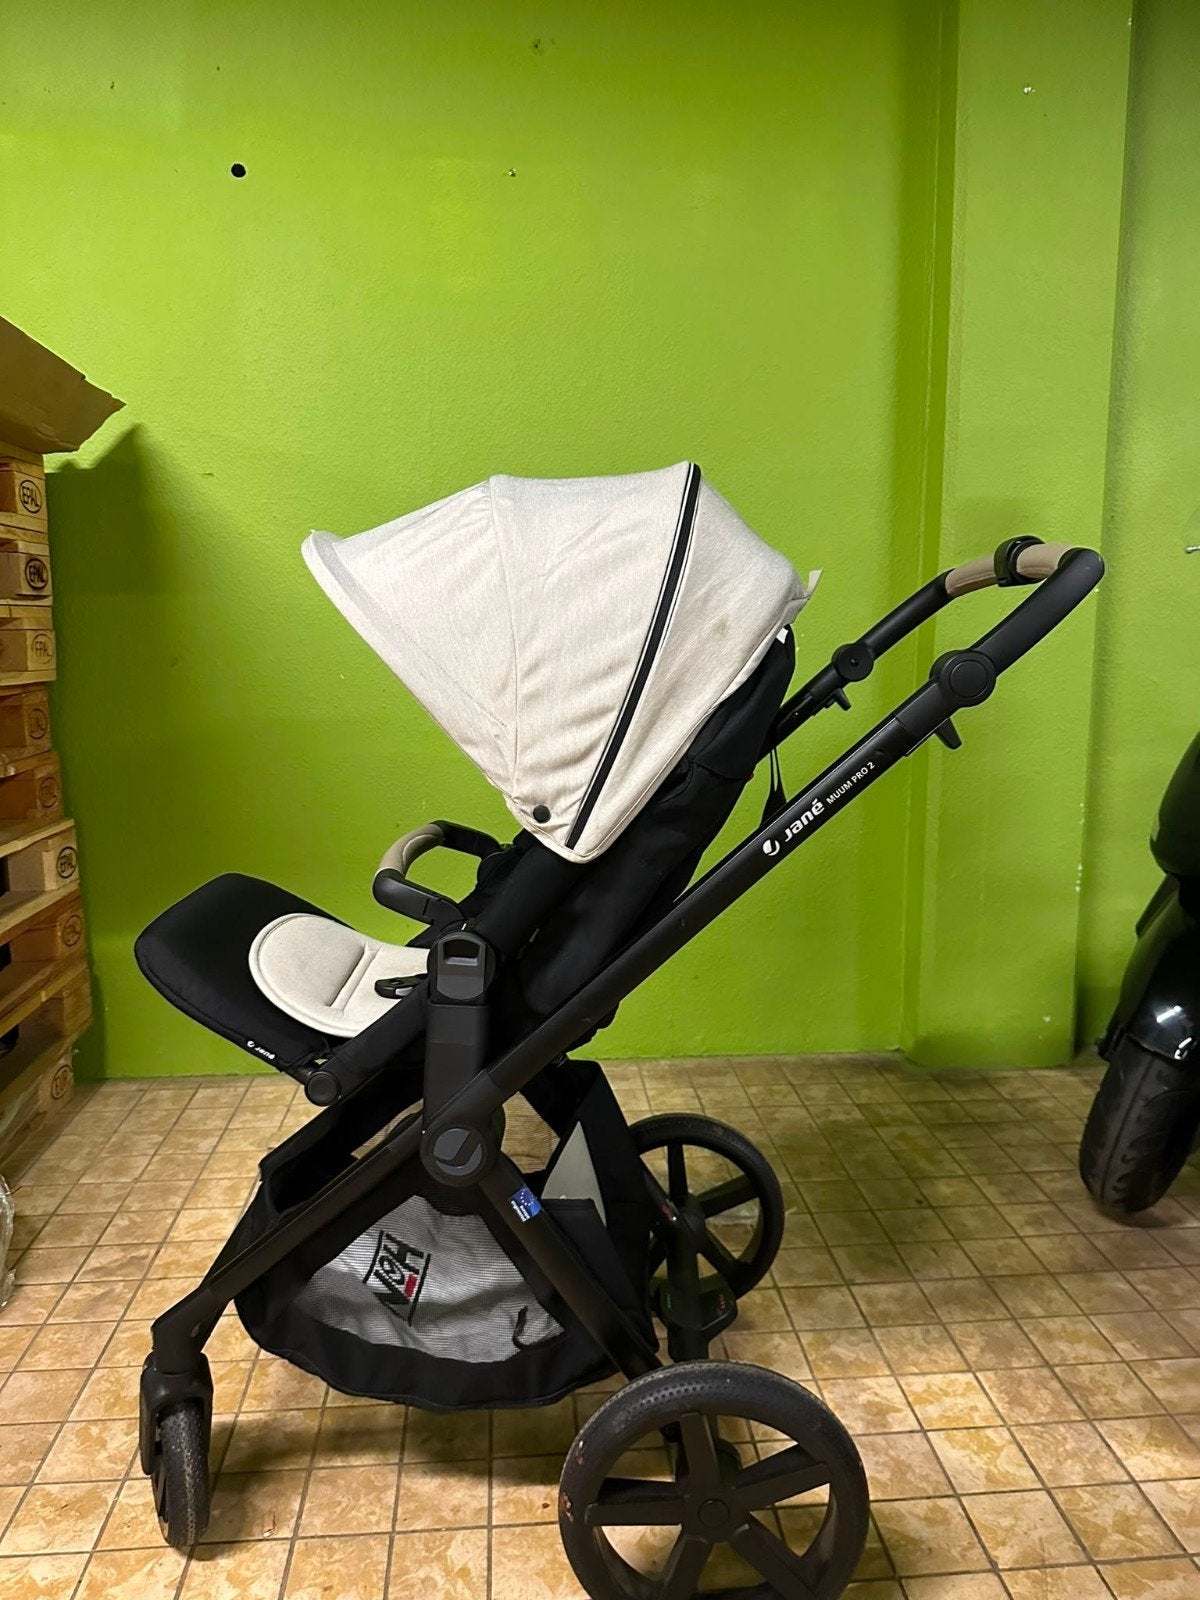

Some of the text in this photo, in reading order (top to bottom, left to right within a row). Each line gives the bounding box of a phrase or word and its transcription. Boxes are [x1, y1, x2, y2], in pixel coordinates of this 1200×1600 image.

[21, 485, 40, 508] EPAL
[826, 780, 853, 804] MUUM
[851, 766, 869, 783] PRO
[867, 762, 876, 770] 2
